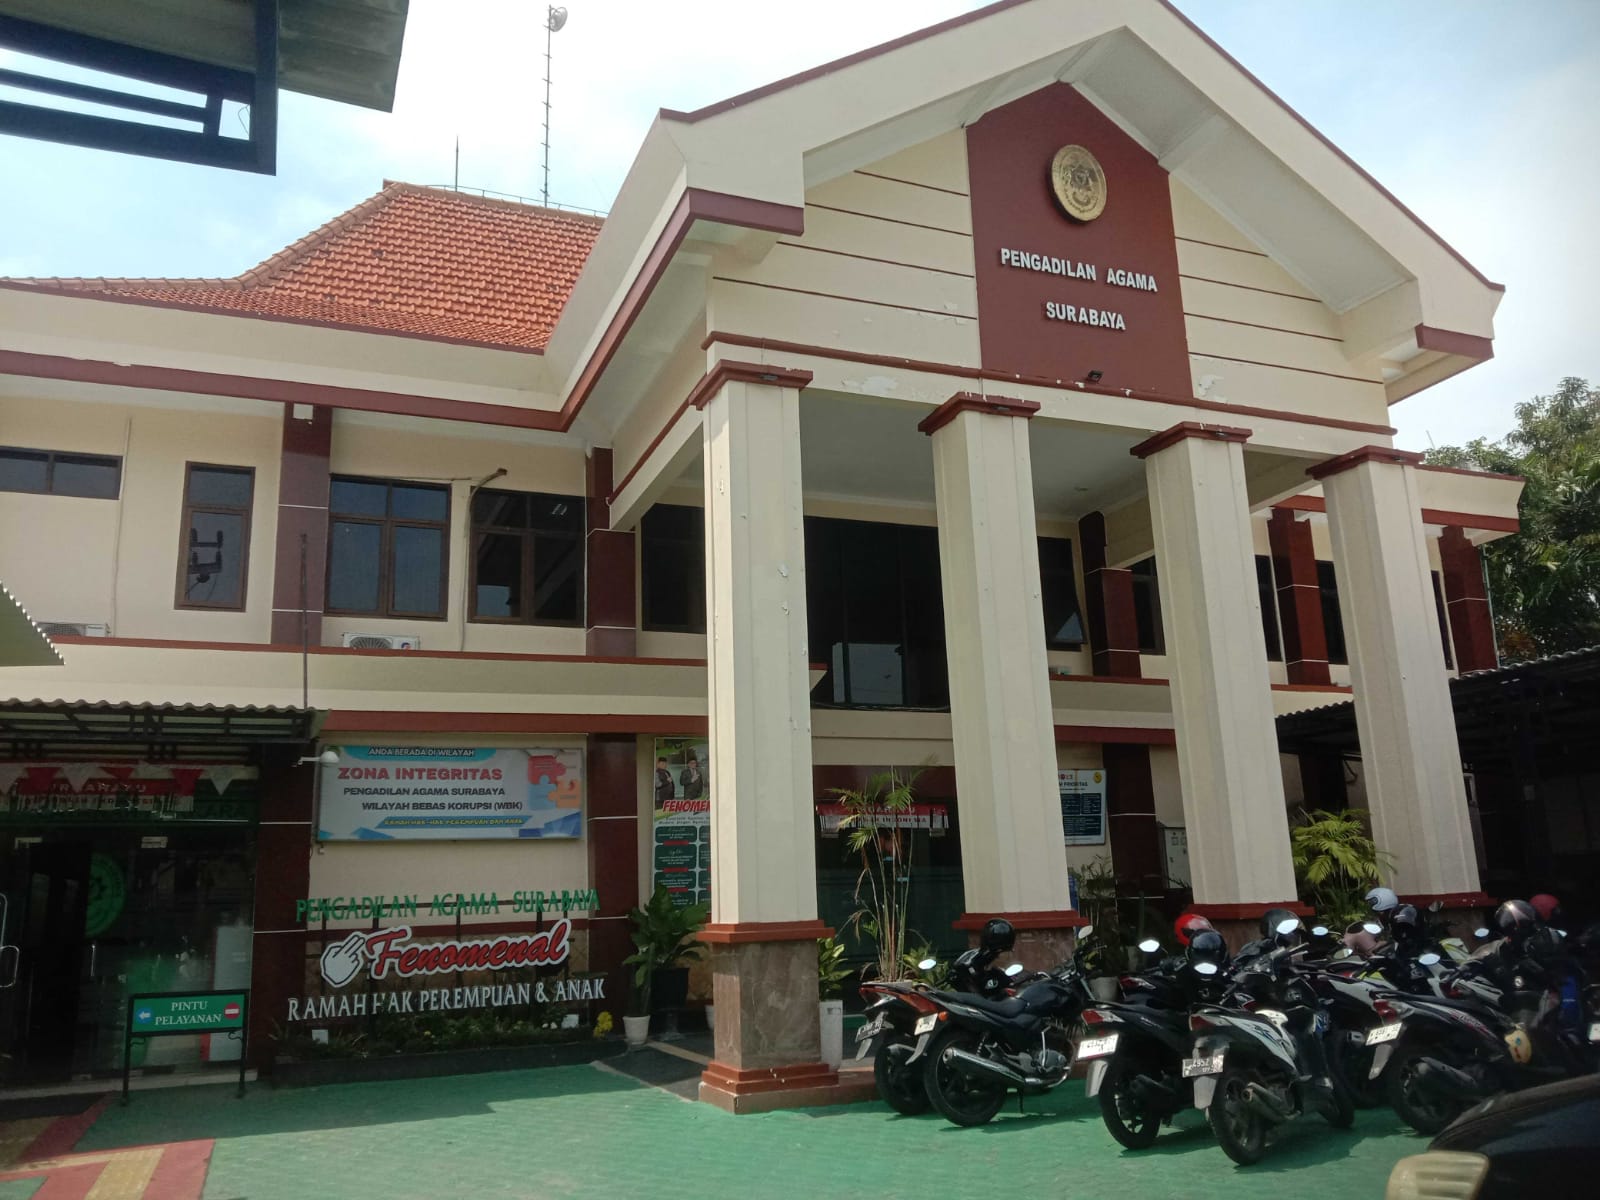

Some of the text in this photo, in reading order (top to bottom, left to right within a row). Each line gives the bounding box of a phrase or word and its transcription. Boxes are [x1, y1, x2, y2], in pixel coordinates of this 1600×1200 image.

[1001, 248, 1158, 292] PENGADILAN AGAMA
[1046, 302, 1126, 330] SURABAYA
[368, 748, 392, 756] ANDA
[438, 749, 474, 757] WILAYAH
[337, 767, 503, 780] ZONA INTEGRITAS
[343, 787, 506, 796] PENGADILAN AGAMA SURABAYA
[362, 801, 523, 811] WILAYAH BEBAS KORUPSI (WBK)
[295, 888, 601, 922] PENGADILAN AGAMA SURABAYA
[364, 918, 571, 980] Fenomenal
[287, 993, 367, 1021] RAMAH
[419, 983, 530, 1012] PEREMPUAN
[535, 982, 549, 1002] &
[555, 978, 606, 1001] ANAK
[171, 1001, 208, 1012] PINTU
[154, 1013, 222, 1026] PELAYANAN
